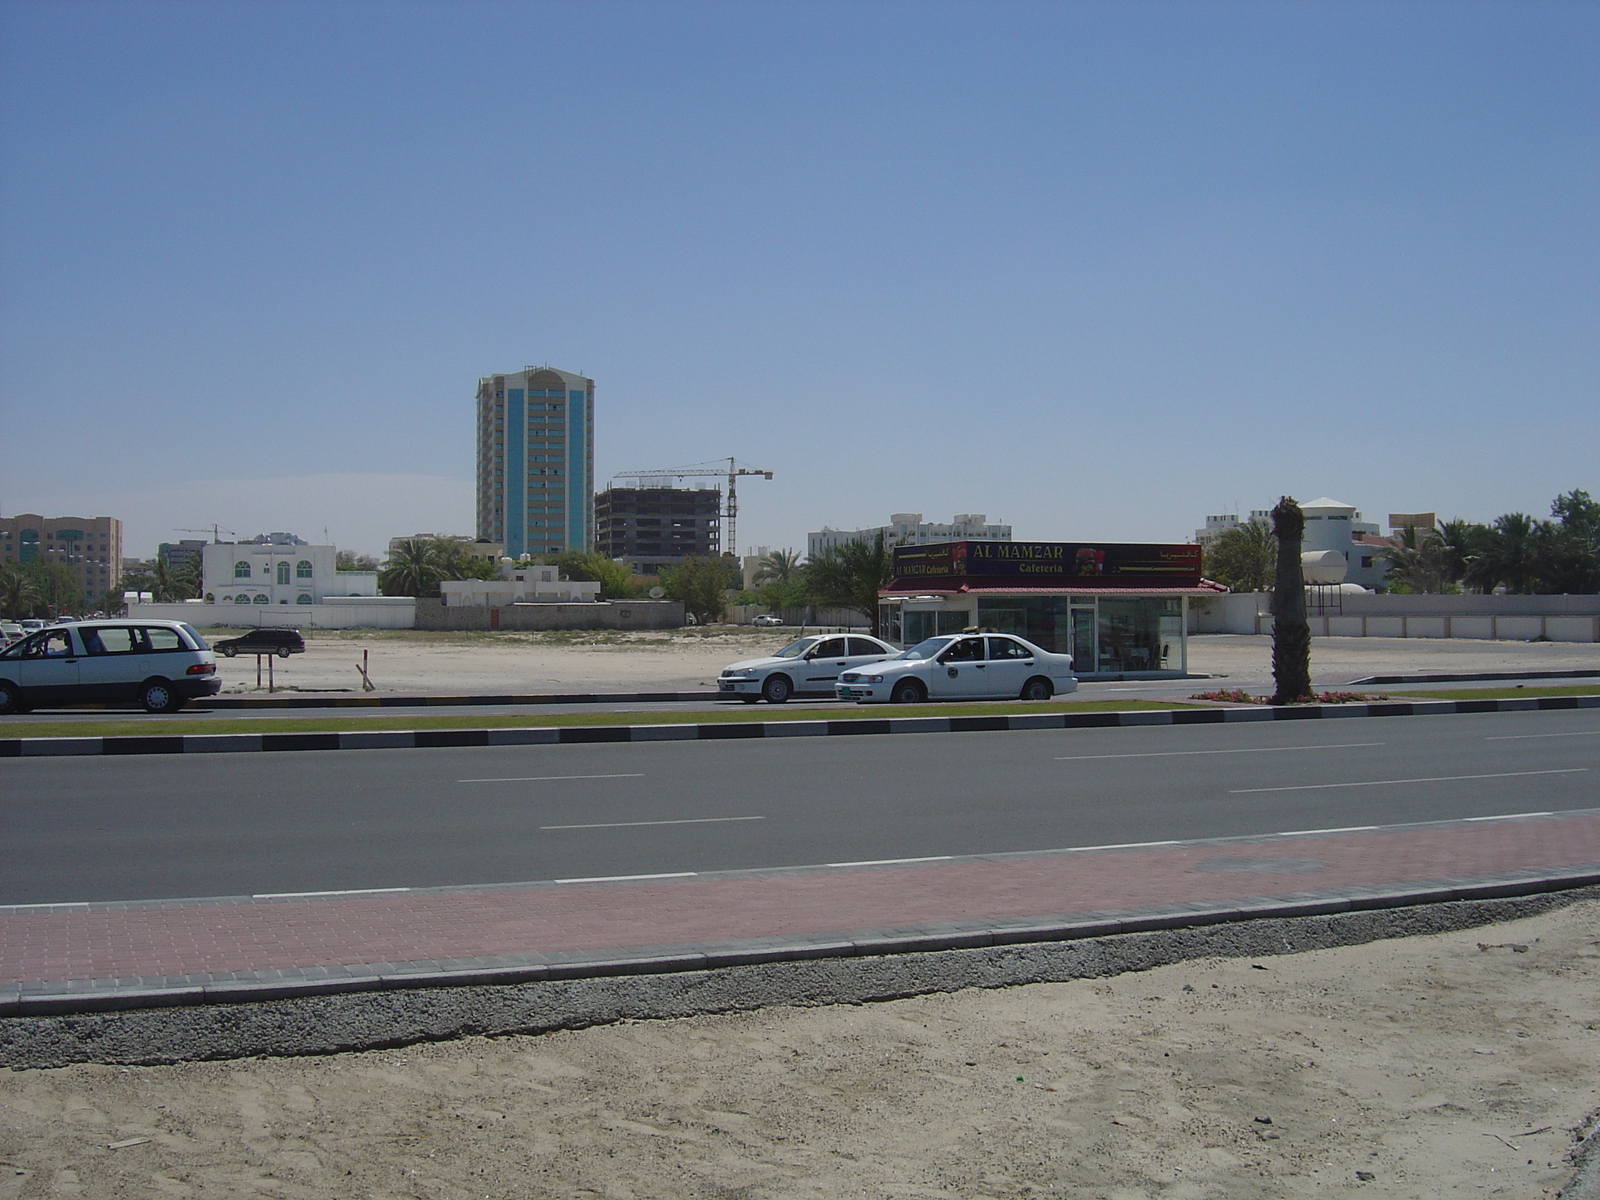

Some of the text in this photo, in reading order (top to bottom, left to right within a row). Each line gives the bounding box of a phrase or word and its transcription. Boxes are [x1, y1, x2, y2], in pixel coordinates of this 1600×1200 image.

[973, 544, 1064, 559] AL MAMZAR
[926, 564, 949, 575] Cafeteria
[1019, 563, 1063, 573] Cafeteria
